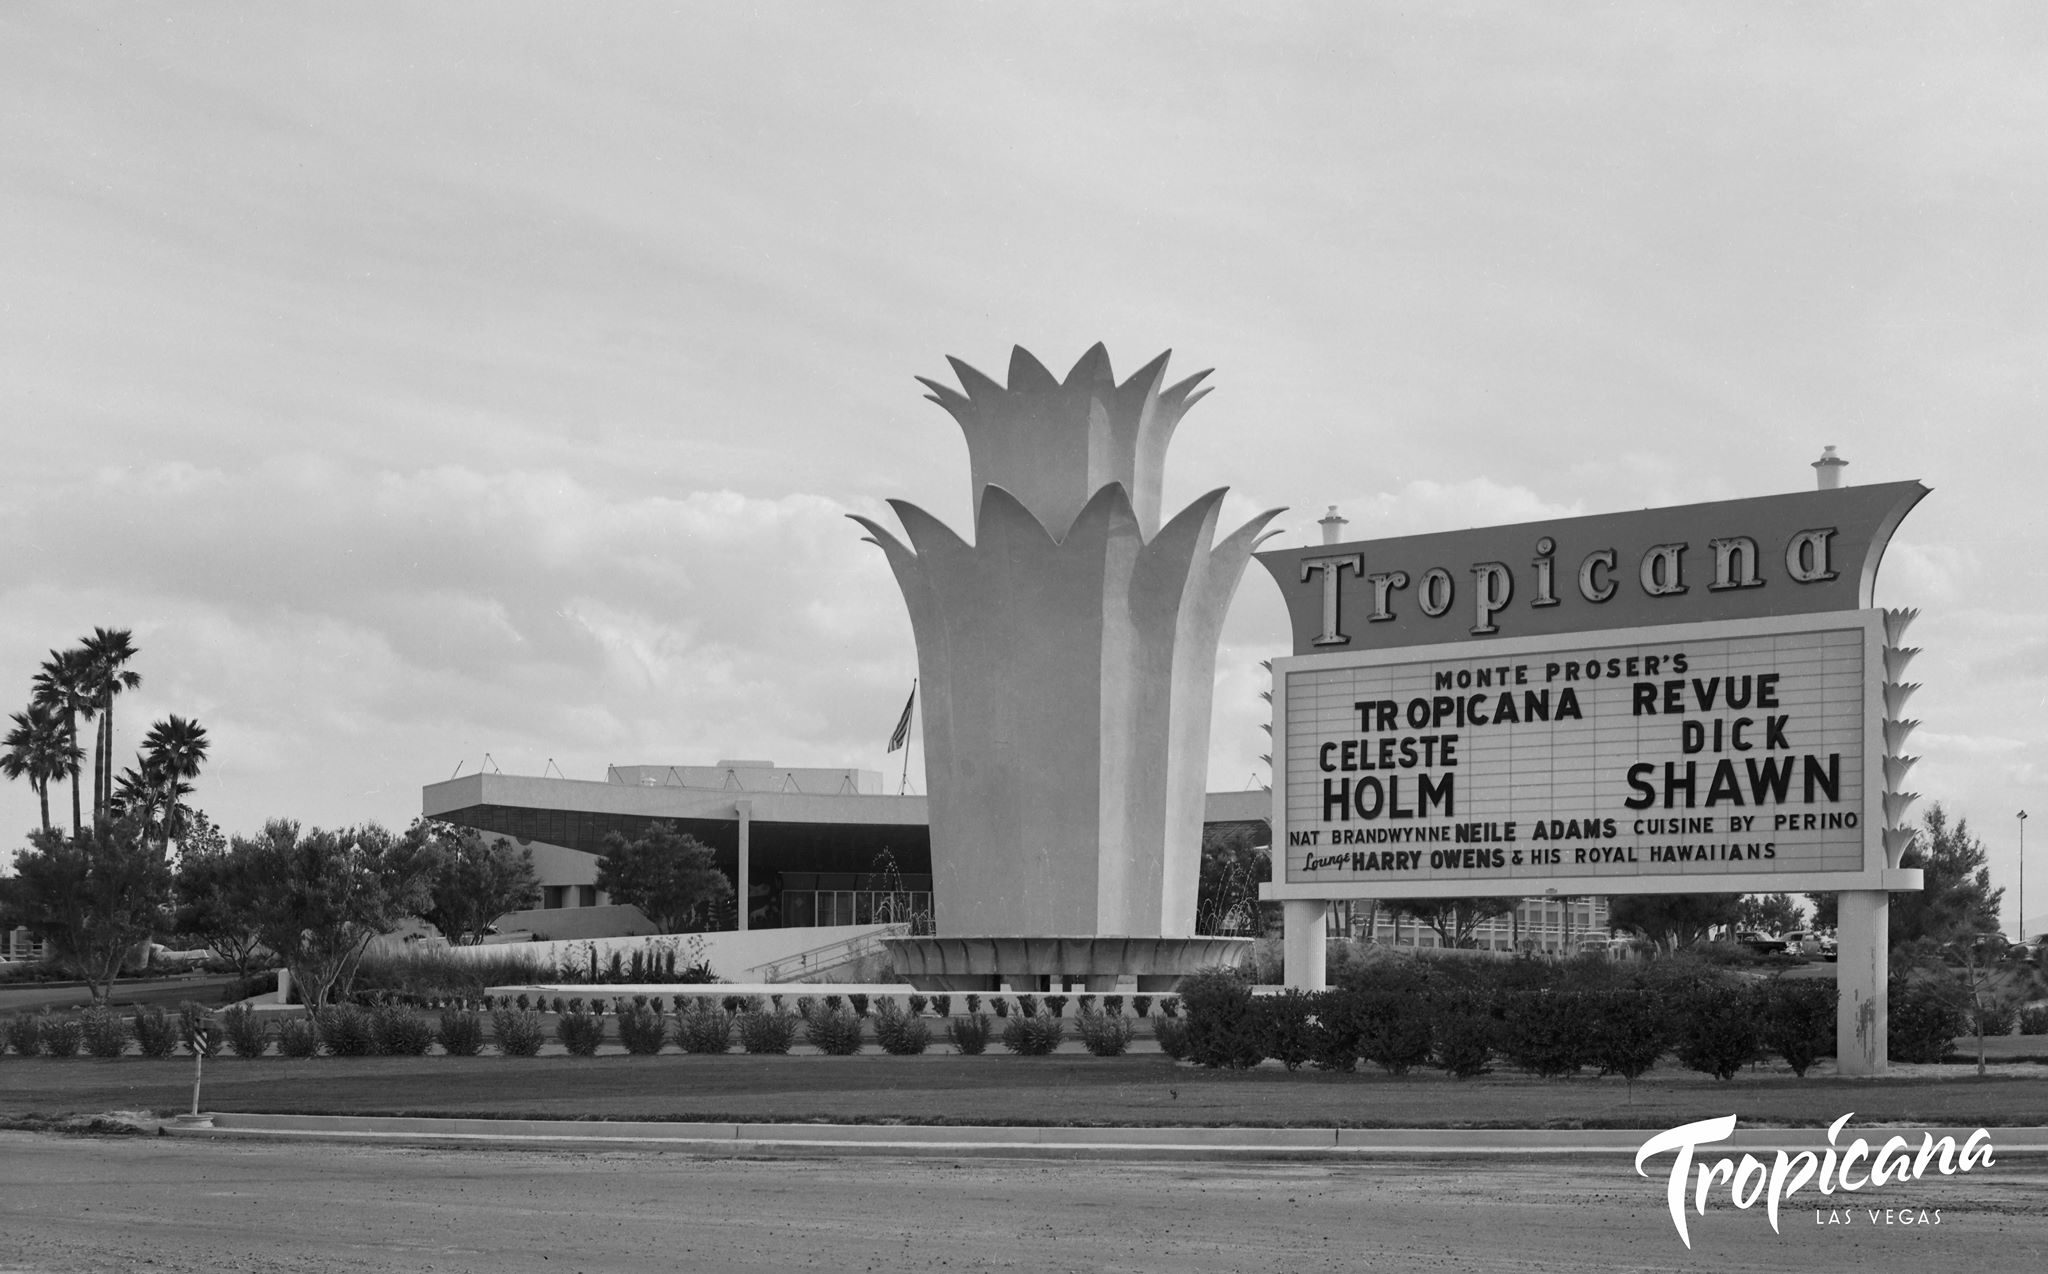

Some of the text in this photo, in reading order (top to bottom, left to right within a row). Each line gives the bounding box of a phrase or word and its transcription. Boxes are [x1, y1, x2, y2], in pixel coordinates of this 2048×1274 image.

[1300, 525, 1841, 648] Tropicana
[1435, 652, 1689, 691] MONTE PROSER'S
[1354, 672, 1781, 733] TROPICANA REVUE
[1319, 733, 1459, 773] CELESTE
[1681, 714, 1791, 755] DICK
[1323, 771, 1455, 822] HOLM
[1623, 752, 1841, 811] SHAWN
[1289, 825, 1451, 847] NAT BRANDWYNNE
[1455, 818, 1617, 844] NEILE ADAMS
[1633, 811, 1859, 836] CUISINE BY PERINO
[1302, 842, 1776, 872] Lounge HARRY OWENS & HIS ROYAL HAWAIIANS
